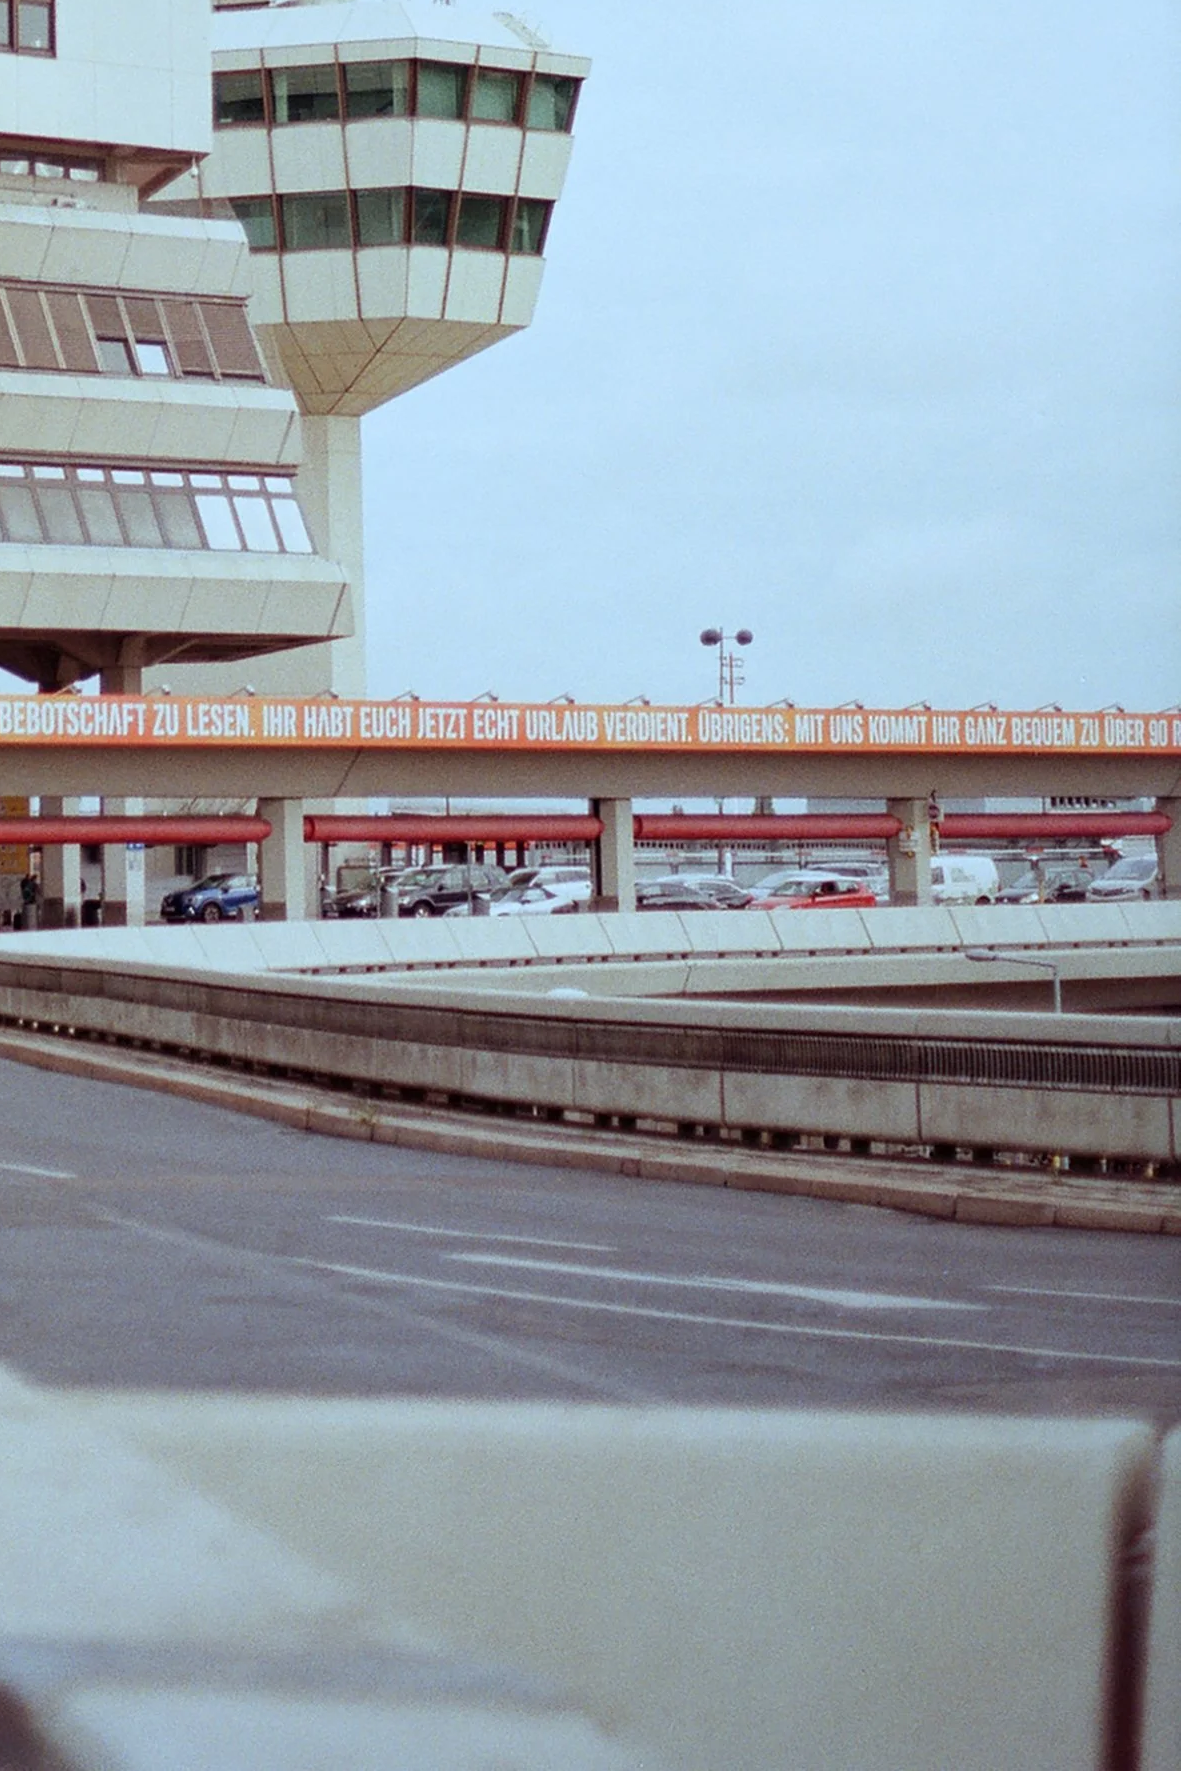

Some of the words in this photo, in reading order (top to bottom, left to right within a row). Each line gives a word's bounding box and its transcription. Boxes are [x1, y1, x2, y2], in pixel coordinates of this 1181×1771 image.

[153, 703, 179, 737] ZU
[186, 703, 256, 738] LESEN.
[262, 704, 297, 739] IHR
[304, 705, 354, 739] HABT
[360, 706, 411, 740] EUCH
[417, 707, 468, 741] JETZT
[473, 708, 519, 742] ECHT
[525, 708, 599, 743] URLAUB
[603, 710, 693, 743] VERDIENT.
[698, 709, 790, 744] ÜBRIGENS:
[794, 713, 825, 745] MIT
[830, 714, 865, 745] UNS
[869, 714, 929, 746] KOMMT
[932, 715, 961, 746] IHR
[965, 715, 1007, 746] GANZ
[1011, 717, 1075, 747] BEQUEM
[1080, 718, 1100, 747] ZU
[1105, 715, 1146, 748] ÜBER
[1149, 719, 1168, 748] 90
